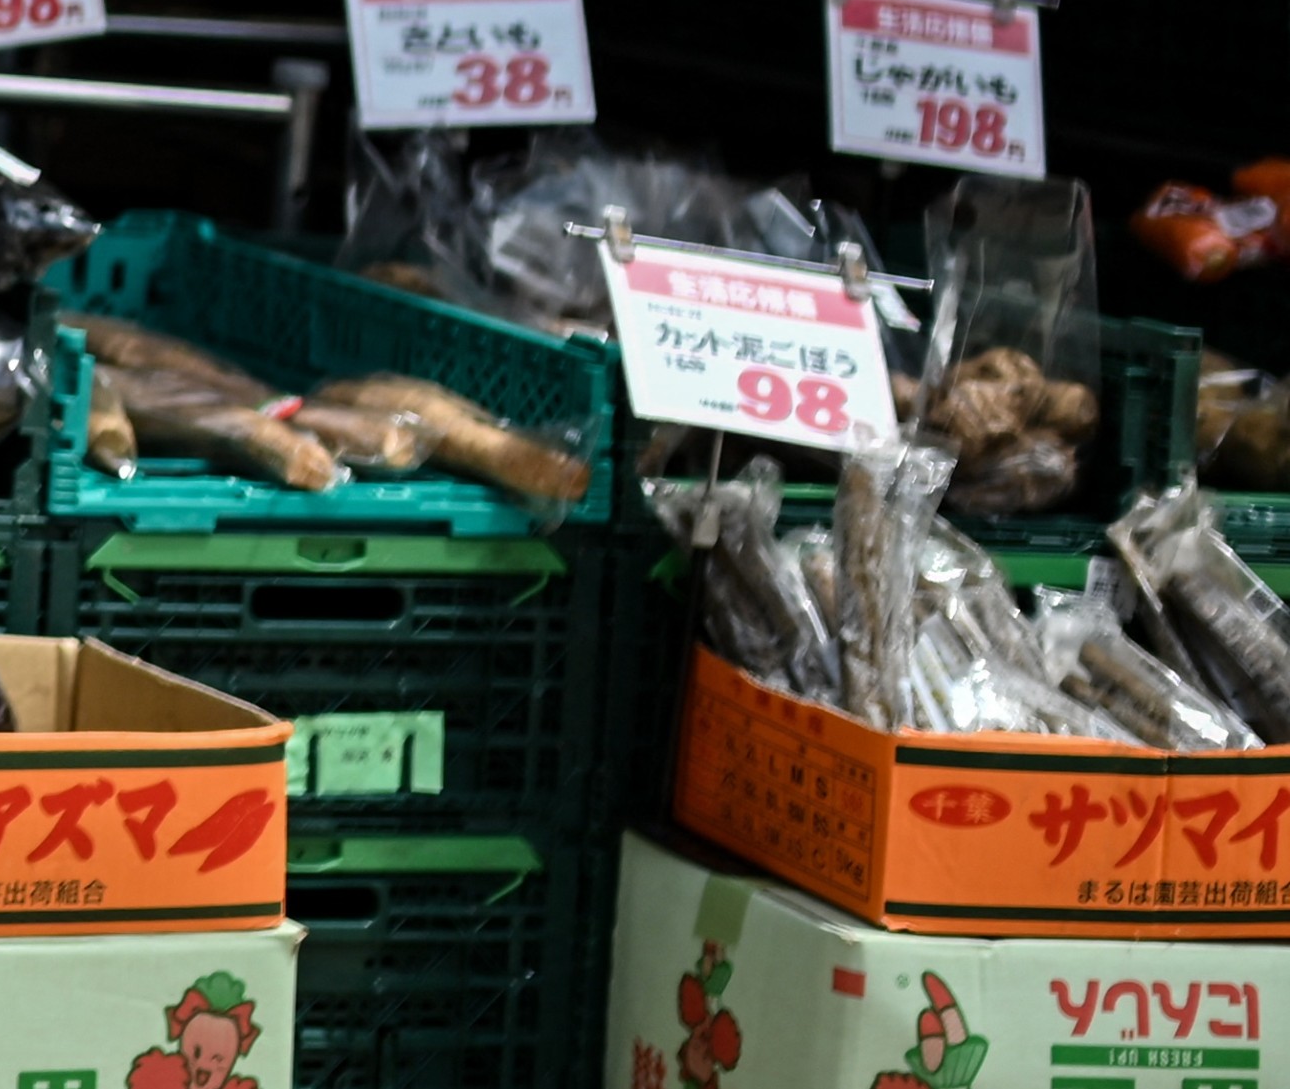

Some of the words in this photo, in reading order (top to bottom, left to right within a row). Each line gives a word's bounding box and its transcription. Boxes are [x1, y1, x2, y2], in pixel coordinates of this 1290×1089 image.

[855, 55, 1016, 104] じゃがいも
[923, 790, 996, 824] 千葉
[1028, 783, 1290, 872] サツマイ
